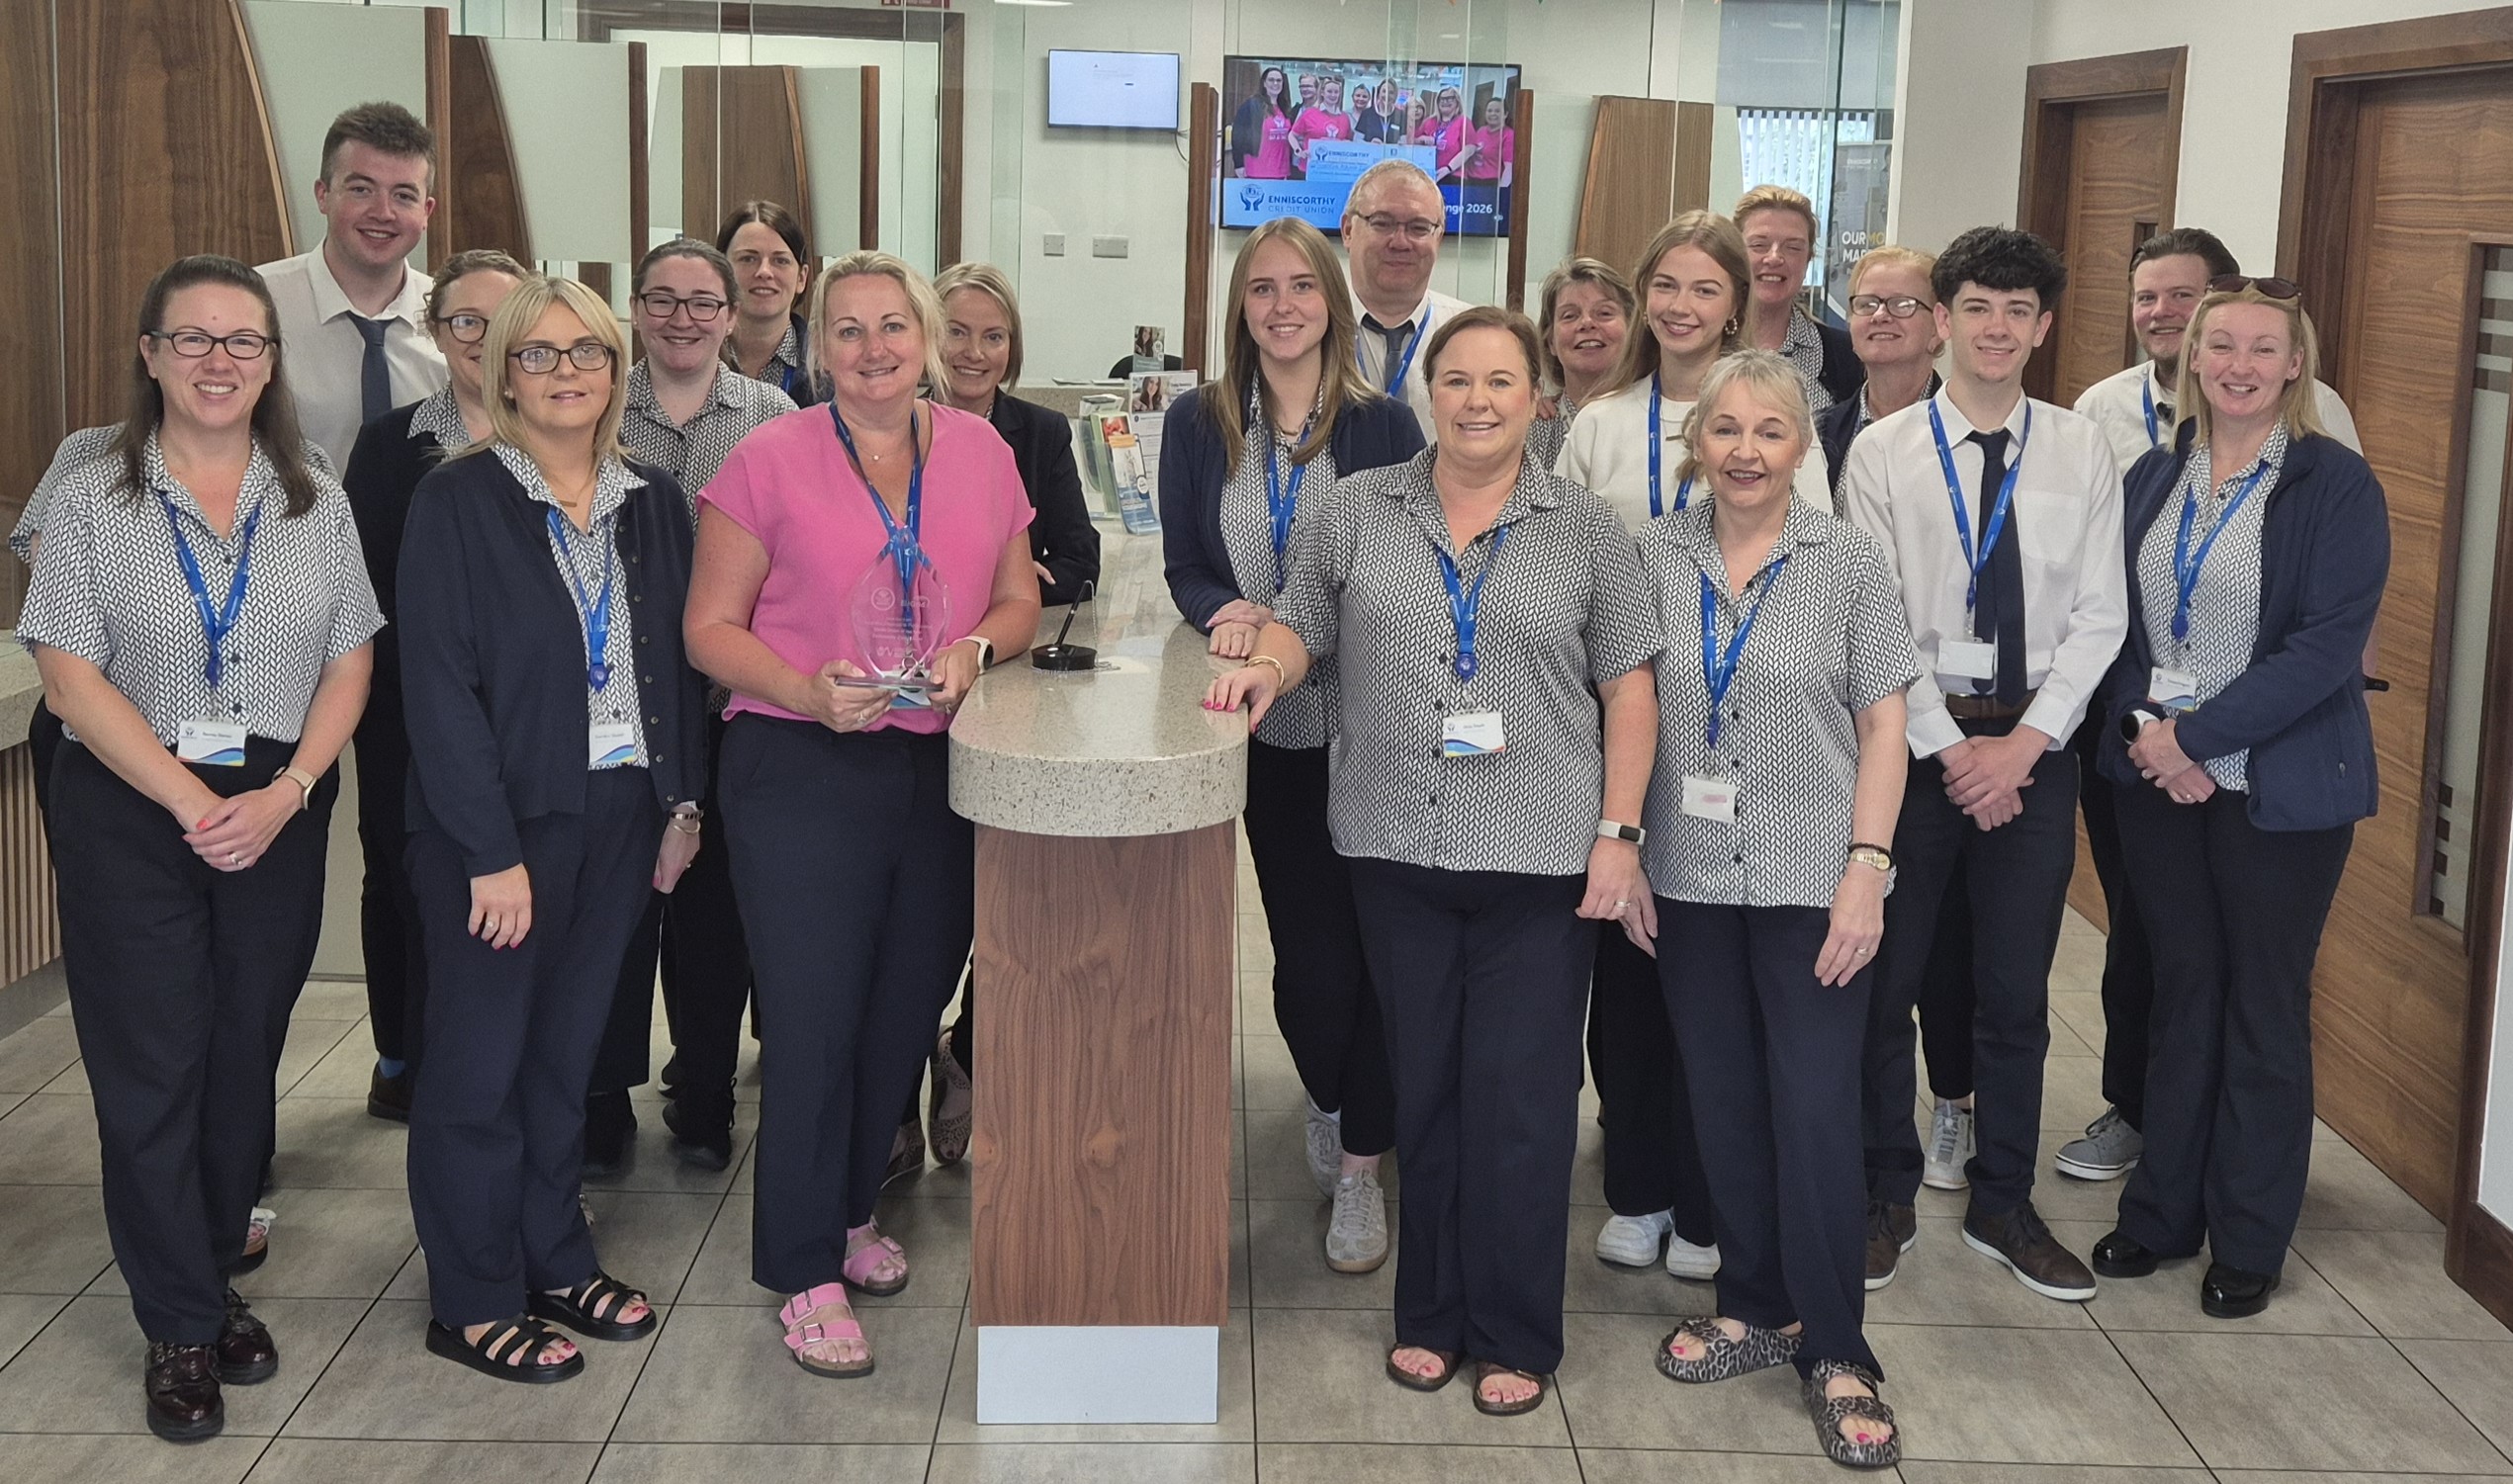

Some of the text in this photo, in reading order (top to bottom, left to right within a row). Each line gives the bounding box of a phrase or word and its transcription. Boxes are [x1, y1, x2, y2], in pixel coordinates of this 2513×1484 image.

[1268, 195, 1336, 206] ENNISCORTHY
[1303, 206, 1334, 215] UNION
[1466, 203, 1493, 215] 2026
[1841, 230, 1866, 245] OUR
